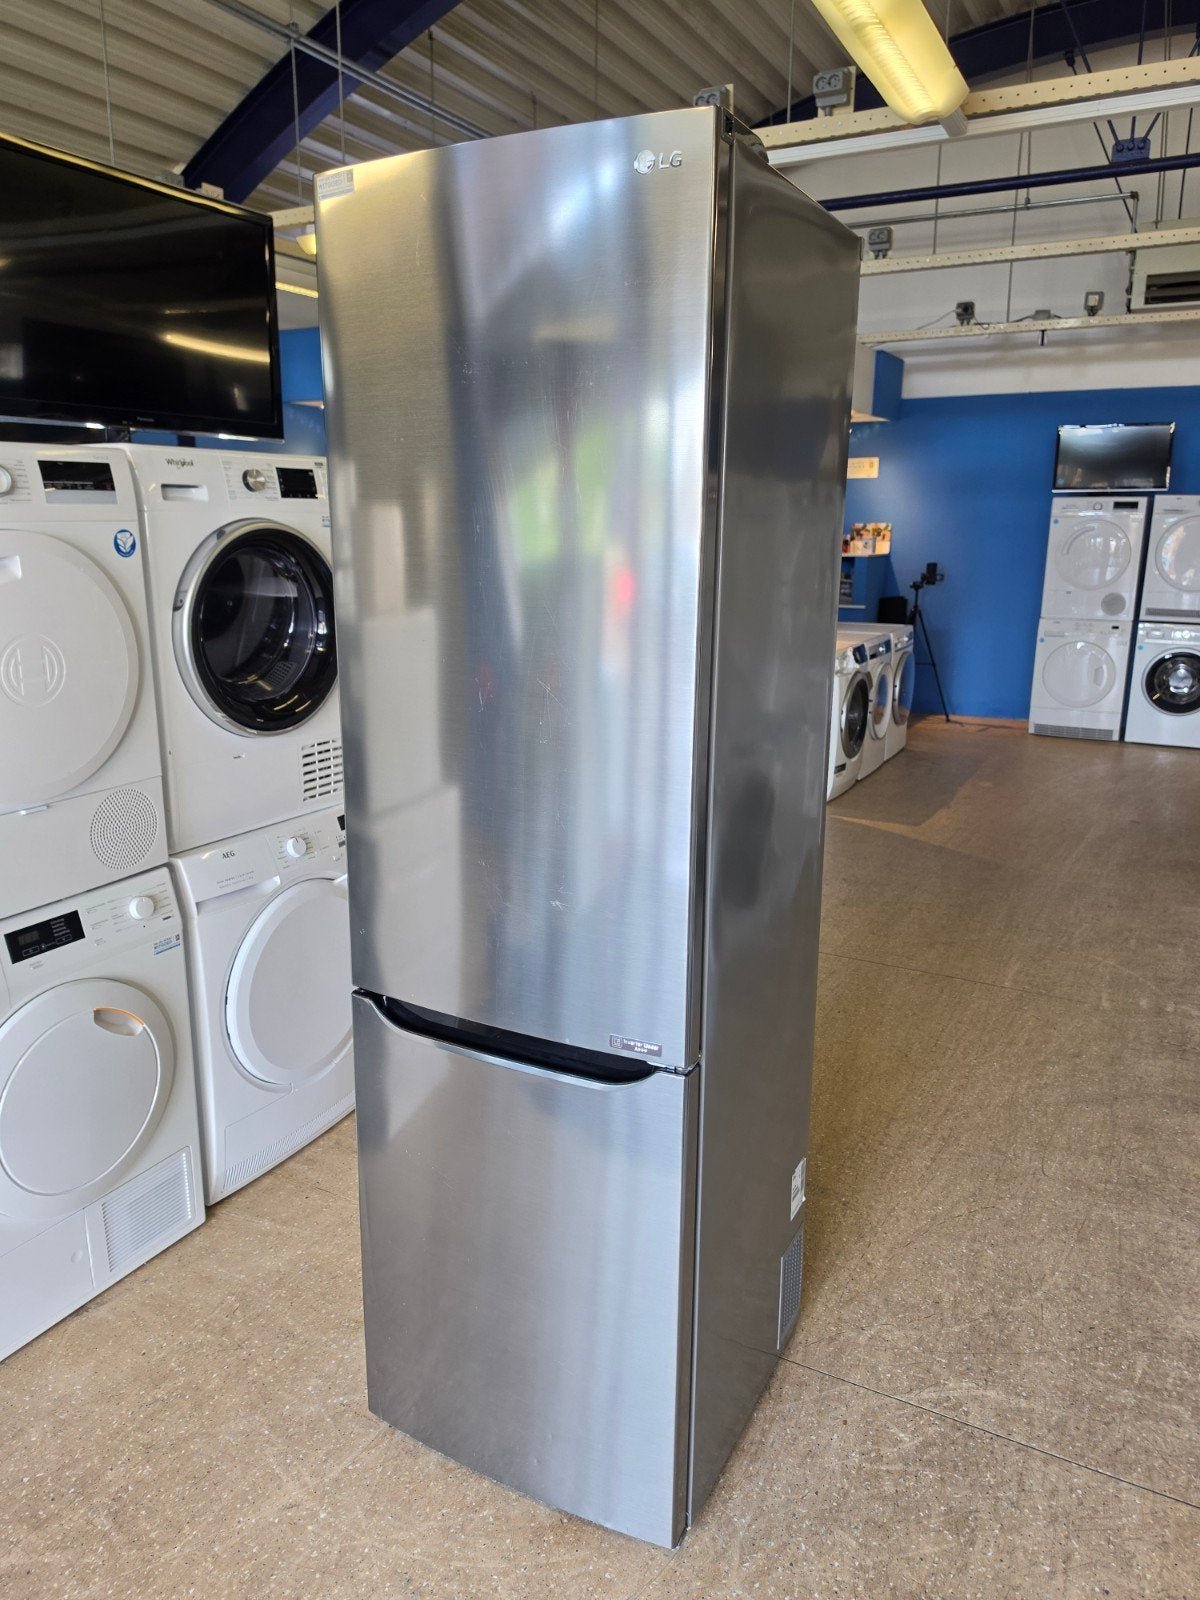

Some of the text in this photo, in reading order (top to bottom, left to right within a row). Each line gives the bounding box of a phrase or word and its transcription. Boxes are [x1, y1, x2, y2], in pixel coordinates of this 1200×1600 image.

[658, 151, 682, 170] LG
[165, 455, 194, 469] Whirlpool
[222, 850, 236, 860] AEG
